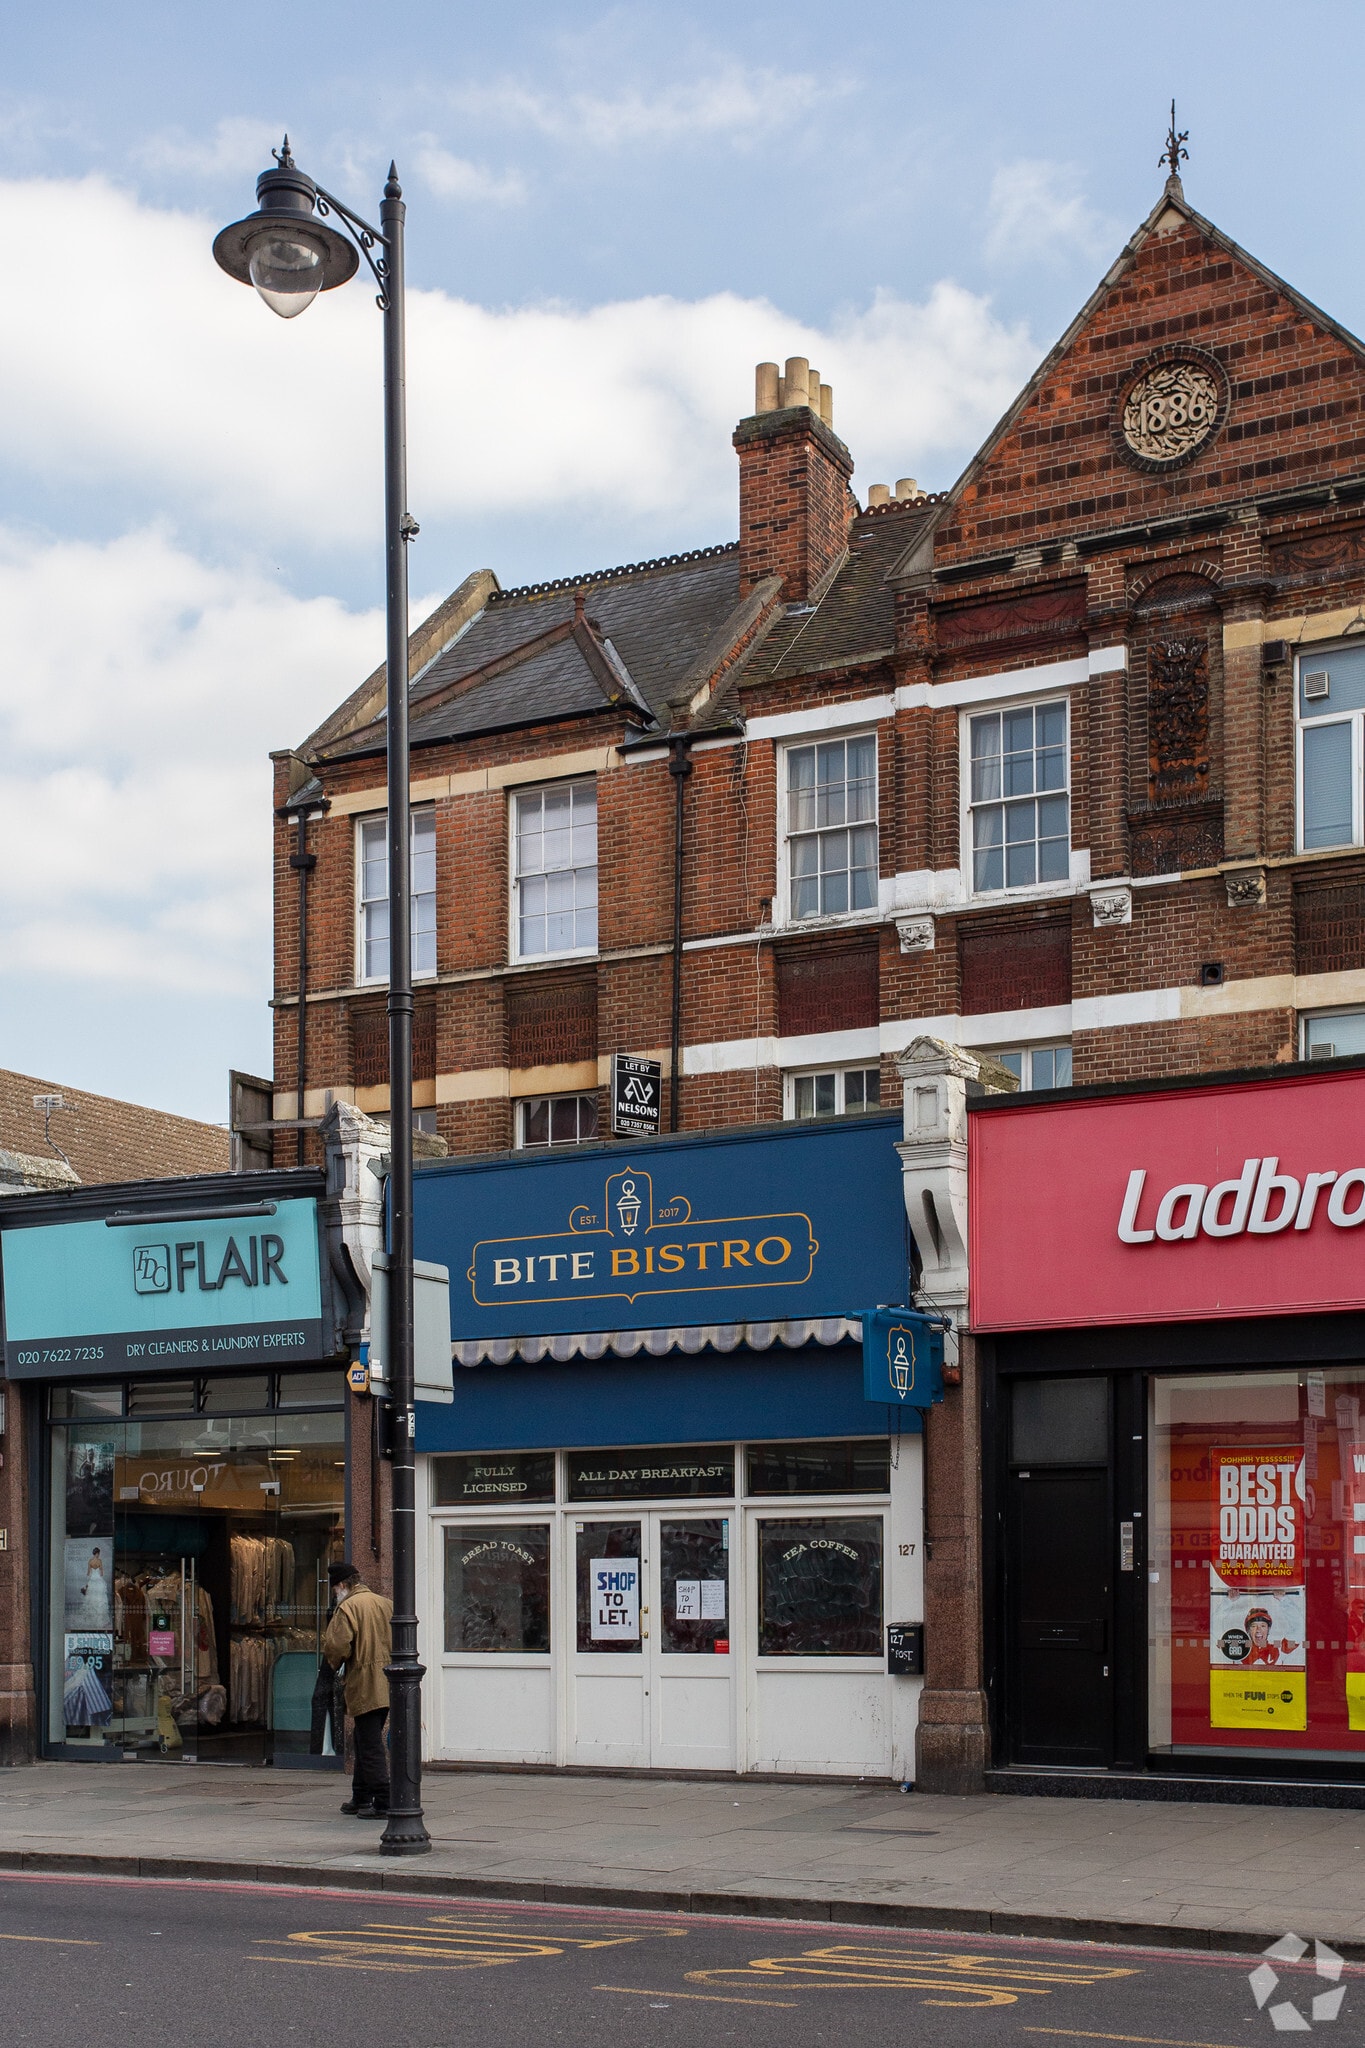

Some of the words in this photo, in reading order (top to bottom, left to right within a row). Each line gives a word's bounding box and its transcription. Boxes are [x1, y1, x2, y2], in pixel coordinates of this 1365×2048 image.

[1141, 390, 1206, 434] 1886
[625, 1062, 639, 1071] LET
[618, 1102, 657, 1117] NELSONS
[1118, 1156, 1365, 1243] Ladbro
[580, 1215, 599, 1225] EST.
[659, 1207, 679, 1218] 2017
[176, 1234, 288, 1292] FLAIR
[492, 1251, 594, 1286] BITE
[610, 1236, 792, 1277] BISTRO
[126, 1343, 146, 1357] DRY
[148, 1340, 199, 1355] CLEANERS
[201, 1339, 210, 1351] &
[212, 1336, 260, 1350] LAUNDRY
[263, 1332, 305, 1348] EXPERTS
[18, 1352, 40, 1364] 020
[42, 1349, 72, 1363] 7622
[74, 1347, 104, 1361] 7235
[352, 1372, 365, 1381] ADT
[474, 1466, 516, 1477] FULLY
[578, 1471, 605, 1481] ALL
[608, 1470, 638, 1480] DAY
[641, 1466, 724, 1479] BREAKFAST
[463, 1482, 527, 1493] LICENSED
[1220, 1464, 1295, 1505] BEST
[1220, 1506, 1295, 1543] ODDS
[461, 1541, 497, 1565] BREAD
[501, 1541, 535, 1565] TOAST
[782, 1544, 808, 1561] TEA
[810, 1540, 859, 1561] COFFEE
[898, 1544, 916, 1556] 127
[1220, 1544, 1295, 1560] GUARANTEED
[597, 1572, 636, 1590] SHOP
[604, 1593, 623, 1606] TO
[678, 1605, 693, 1614] LET
[68, 1637, 74, 1648] 5
[77, 1638, 110, 1649] SHIRTS
[891, 1634, 904, 1645] 127
[1244, 1692, 1266, 1701] FUN
